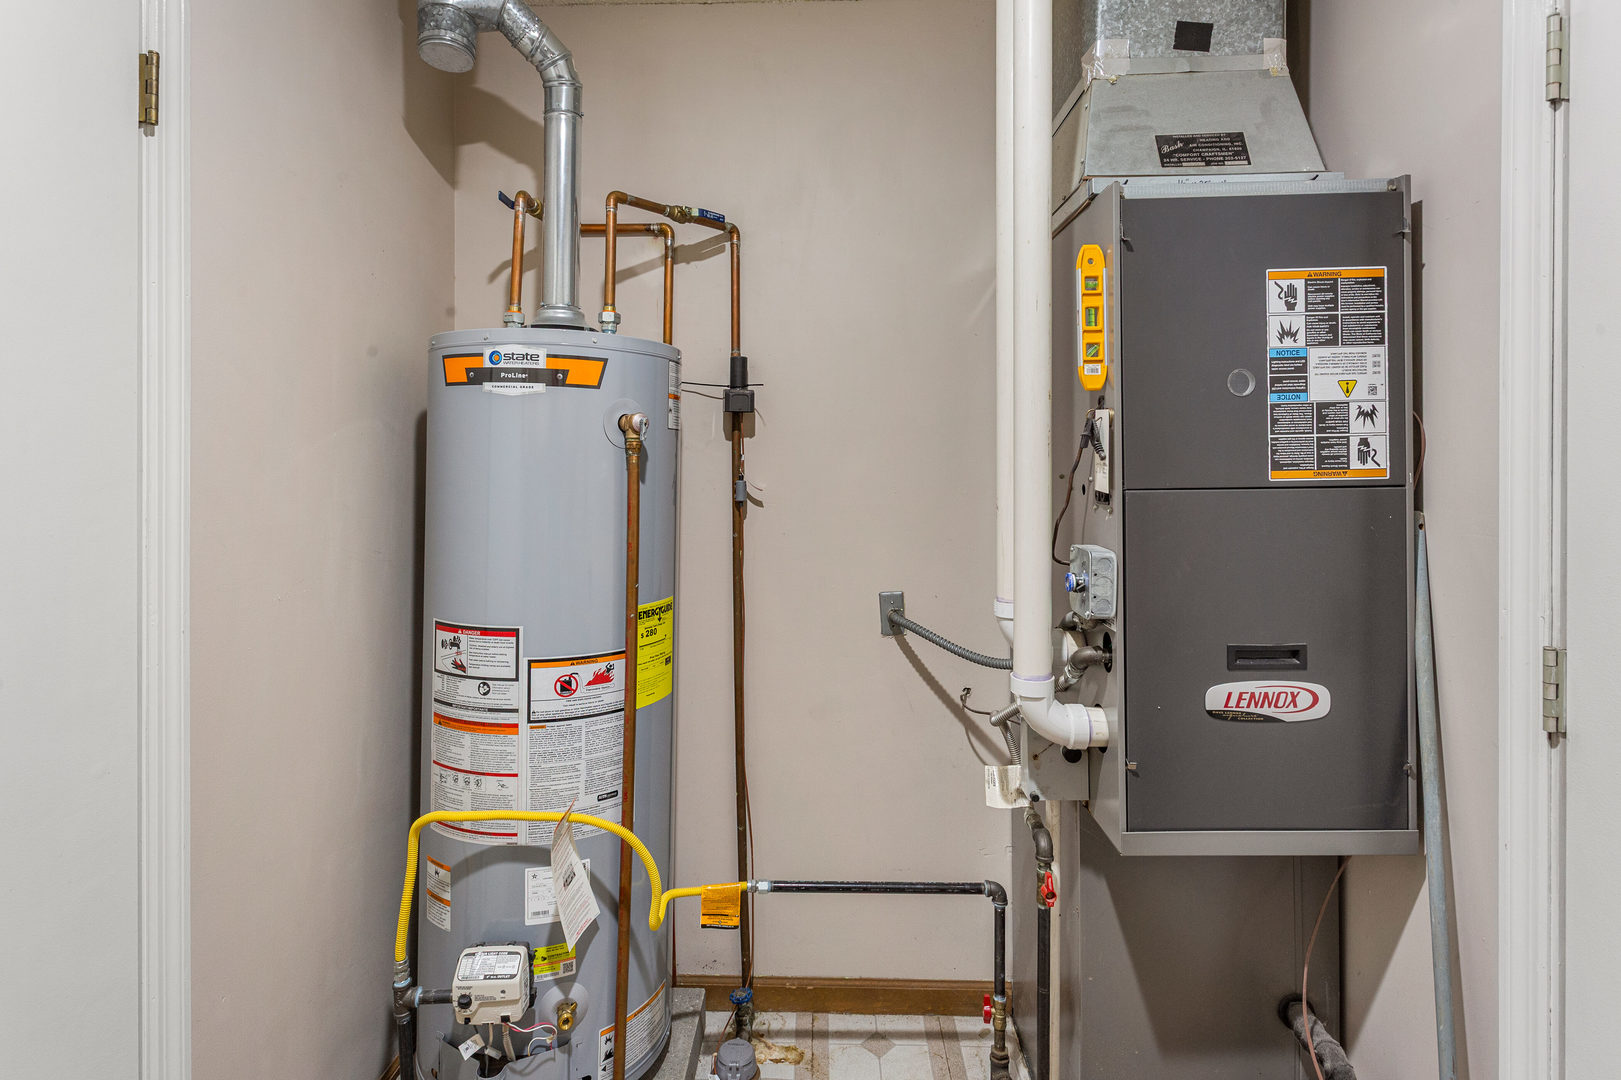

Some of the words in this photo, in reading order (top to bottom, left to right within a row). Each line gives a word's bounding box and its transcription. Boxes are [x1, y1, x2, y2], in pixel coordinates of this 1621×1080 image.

[1160, 140, 1184, 154] Bash
[503, 352, 540, 361] state
[646, 628, 657, 638] 280
[1224, 692, 1300, 708] LENNOX
